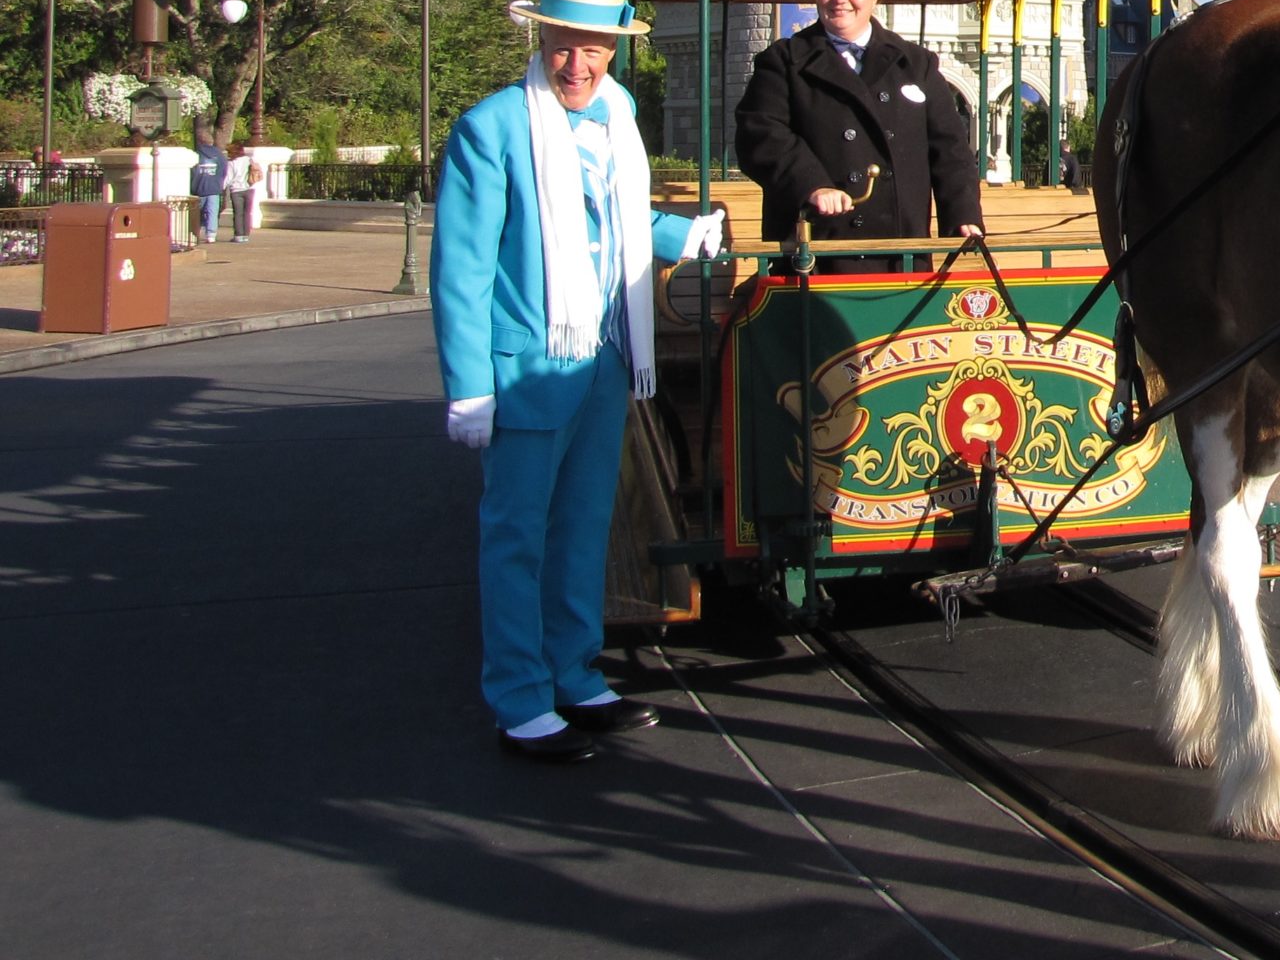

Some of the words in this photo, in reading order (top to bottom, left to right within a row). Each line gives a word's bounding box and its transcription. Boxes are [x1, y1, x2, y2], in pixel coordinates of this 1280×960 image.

[843, 336, 952, 383] MAIN
[974, 334, 1114, 374] STREET
[961, 393, 1003, 444] 2
[829, 485, 1086, 521] TRANSPOATION
